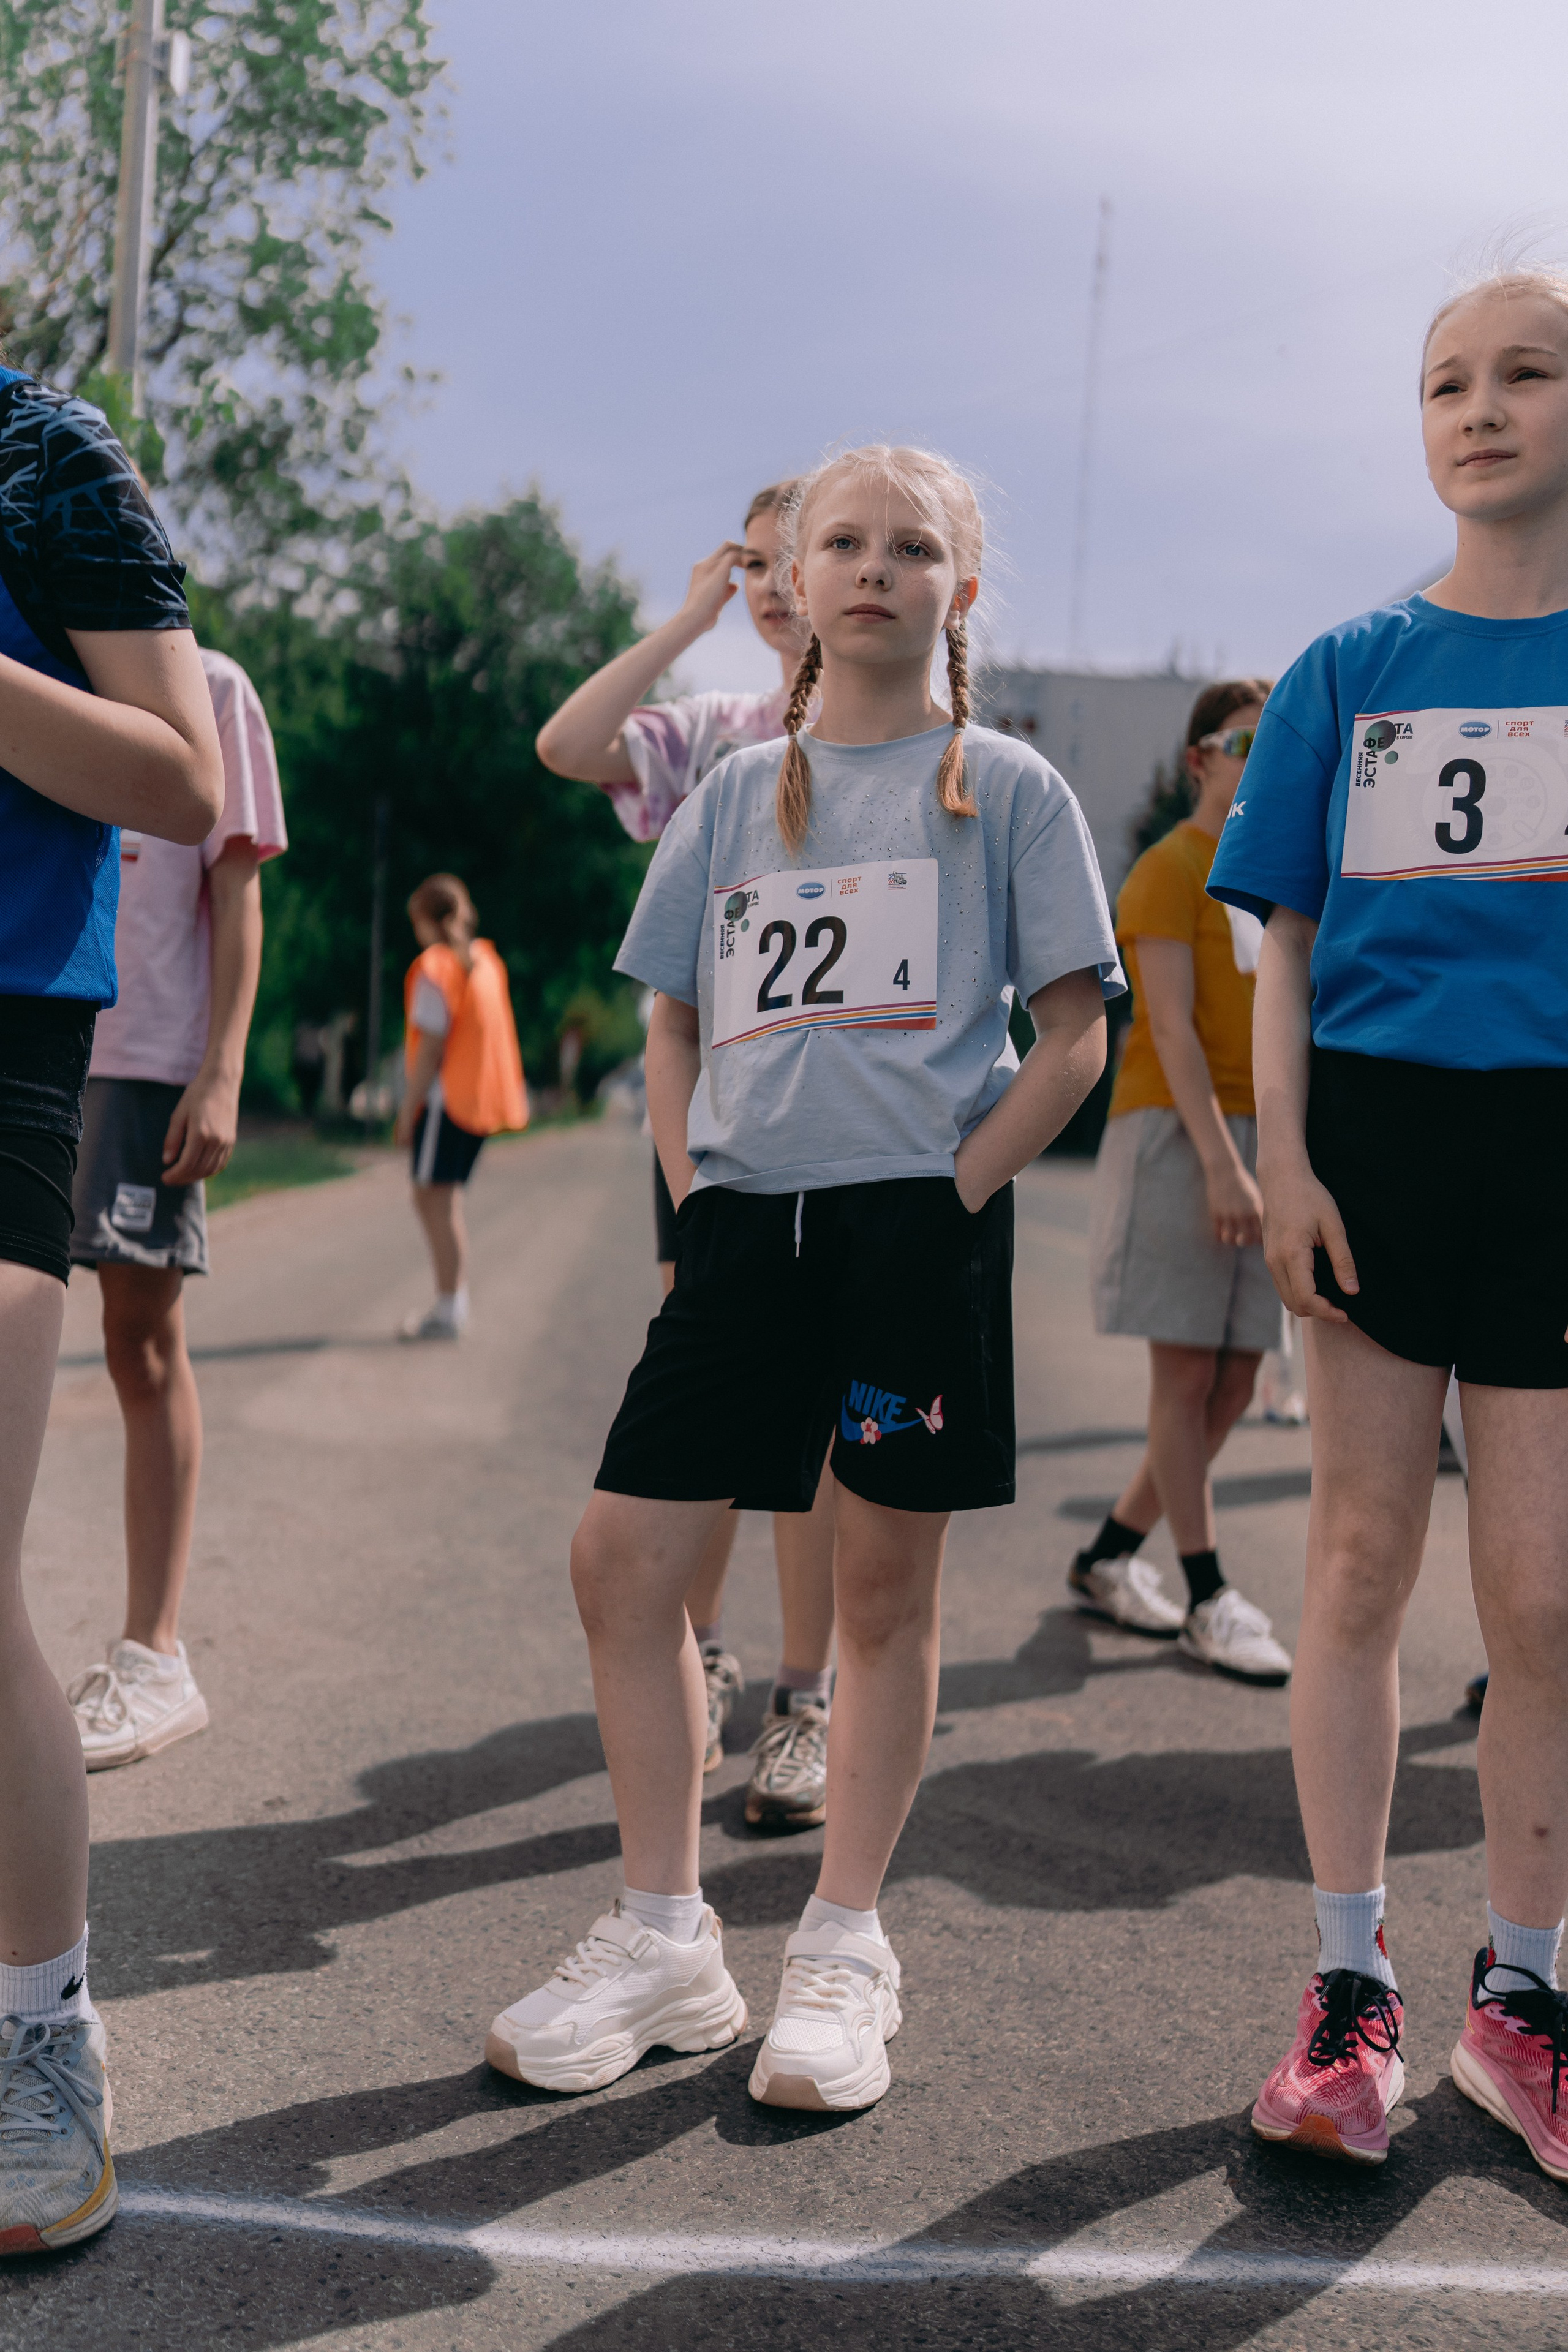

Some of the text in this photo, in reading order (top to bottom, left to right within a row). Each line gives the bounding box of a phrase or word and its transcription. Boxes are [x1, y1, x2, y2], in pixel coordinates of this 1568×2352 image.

[1434, 758, 1487, 854] 3
[757, 916, 847, 1012] 22
[892, 959, 910, 990] 4
[849, 1379, 907, 1425] NIKE
